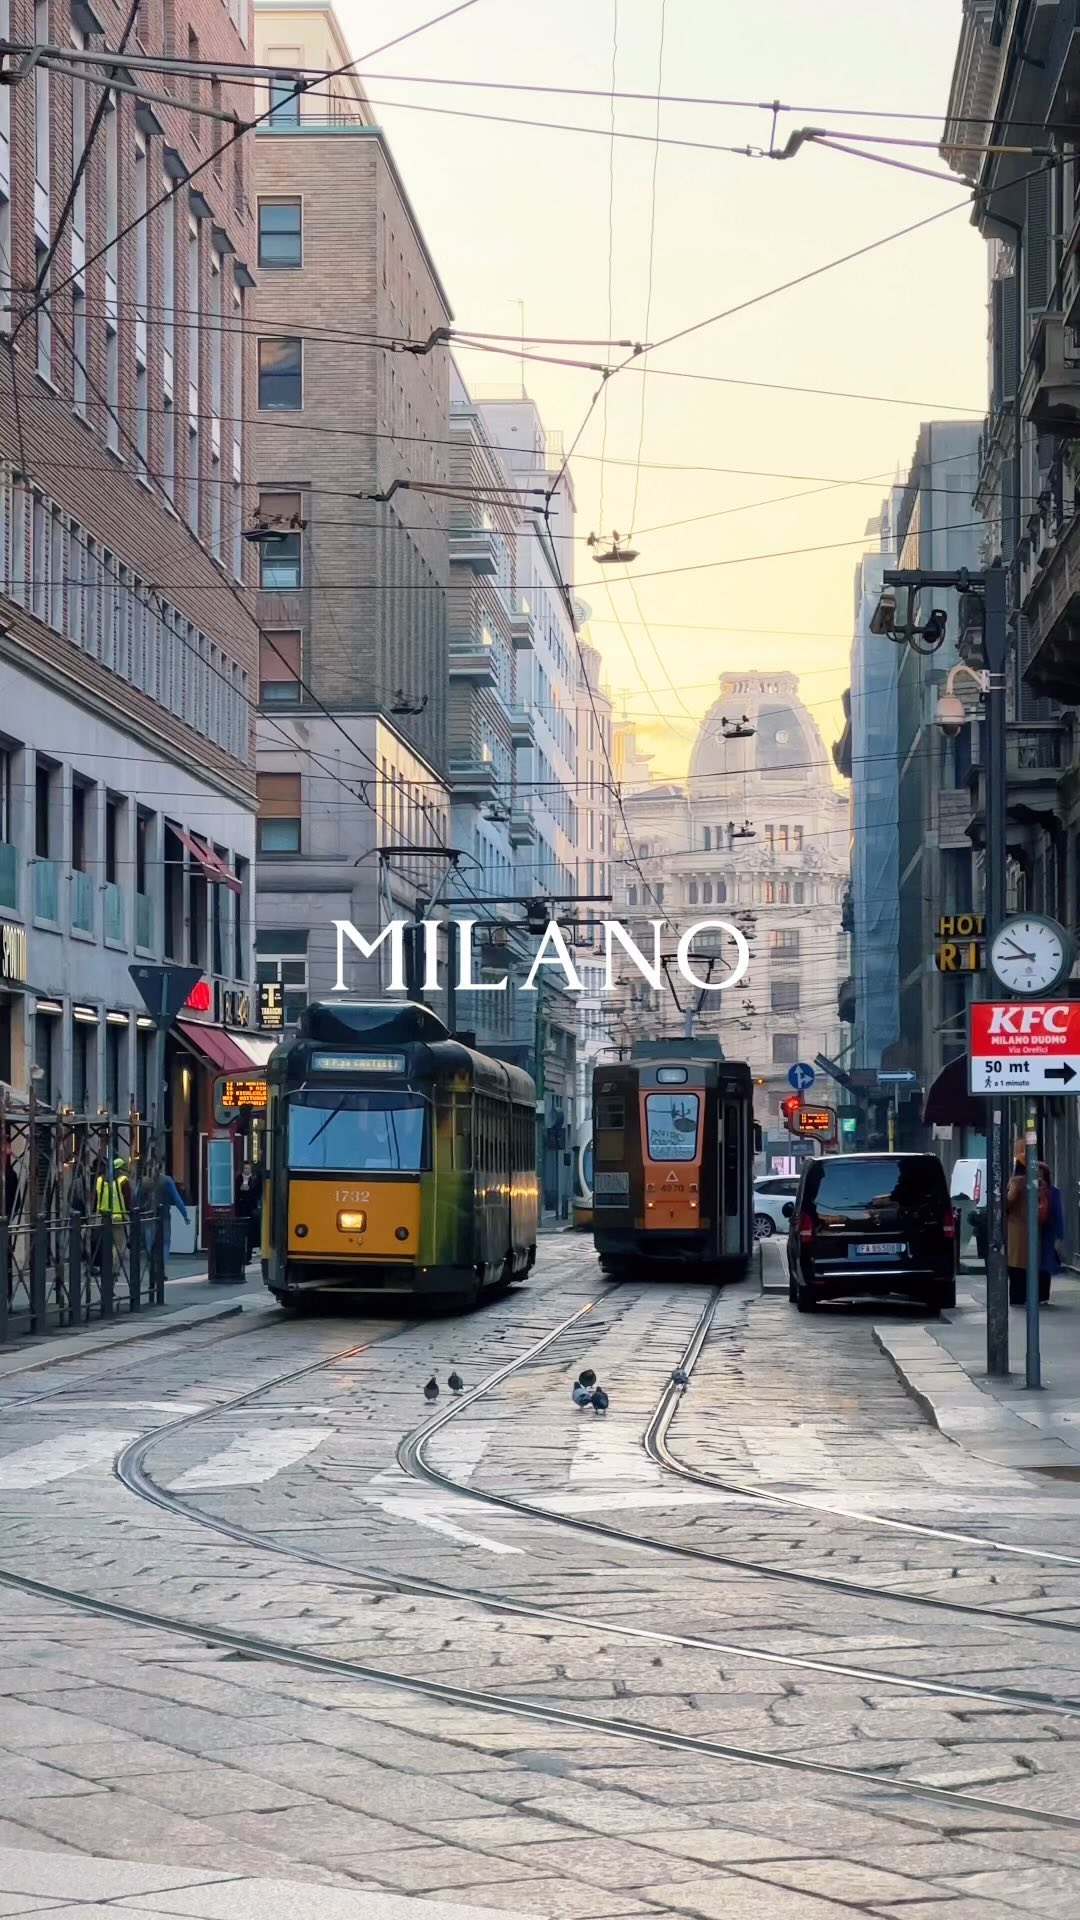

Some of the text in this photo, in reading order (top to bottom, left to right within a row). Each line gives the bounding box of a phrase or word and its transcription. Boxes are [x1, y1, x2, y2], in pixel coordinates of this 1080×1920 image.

[987, 1006, 1070, 1033] KFC
[991, 1035, 1067, 1045] MILANO DUOMO
[985, 1061, 1030, 1073] 50 mt
[335, 1190, 370, 1203] 1732
